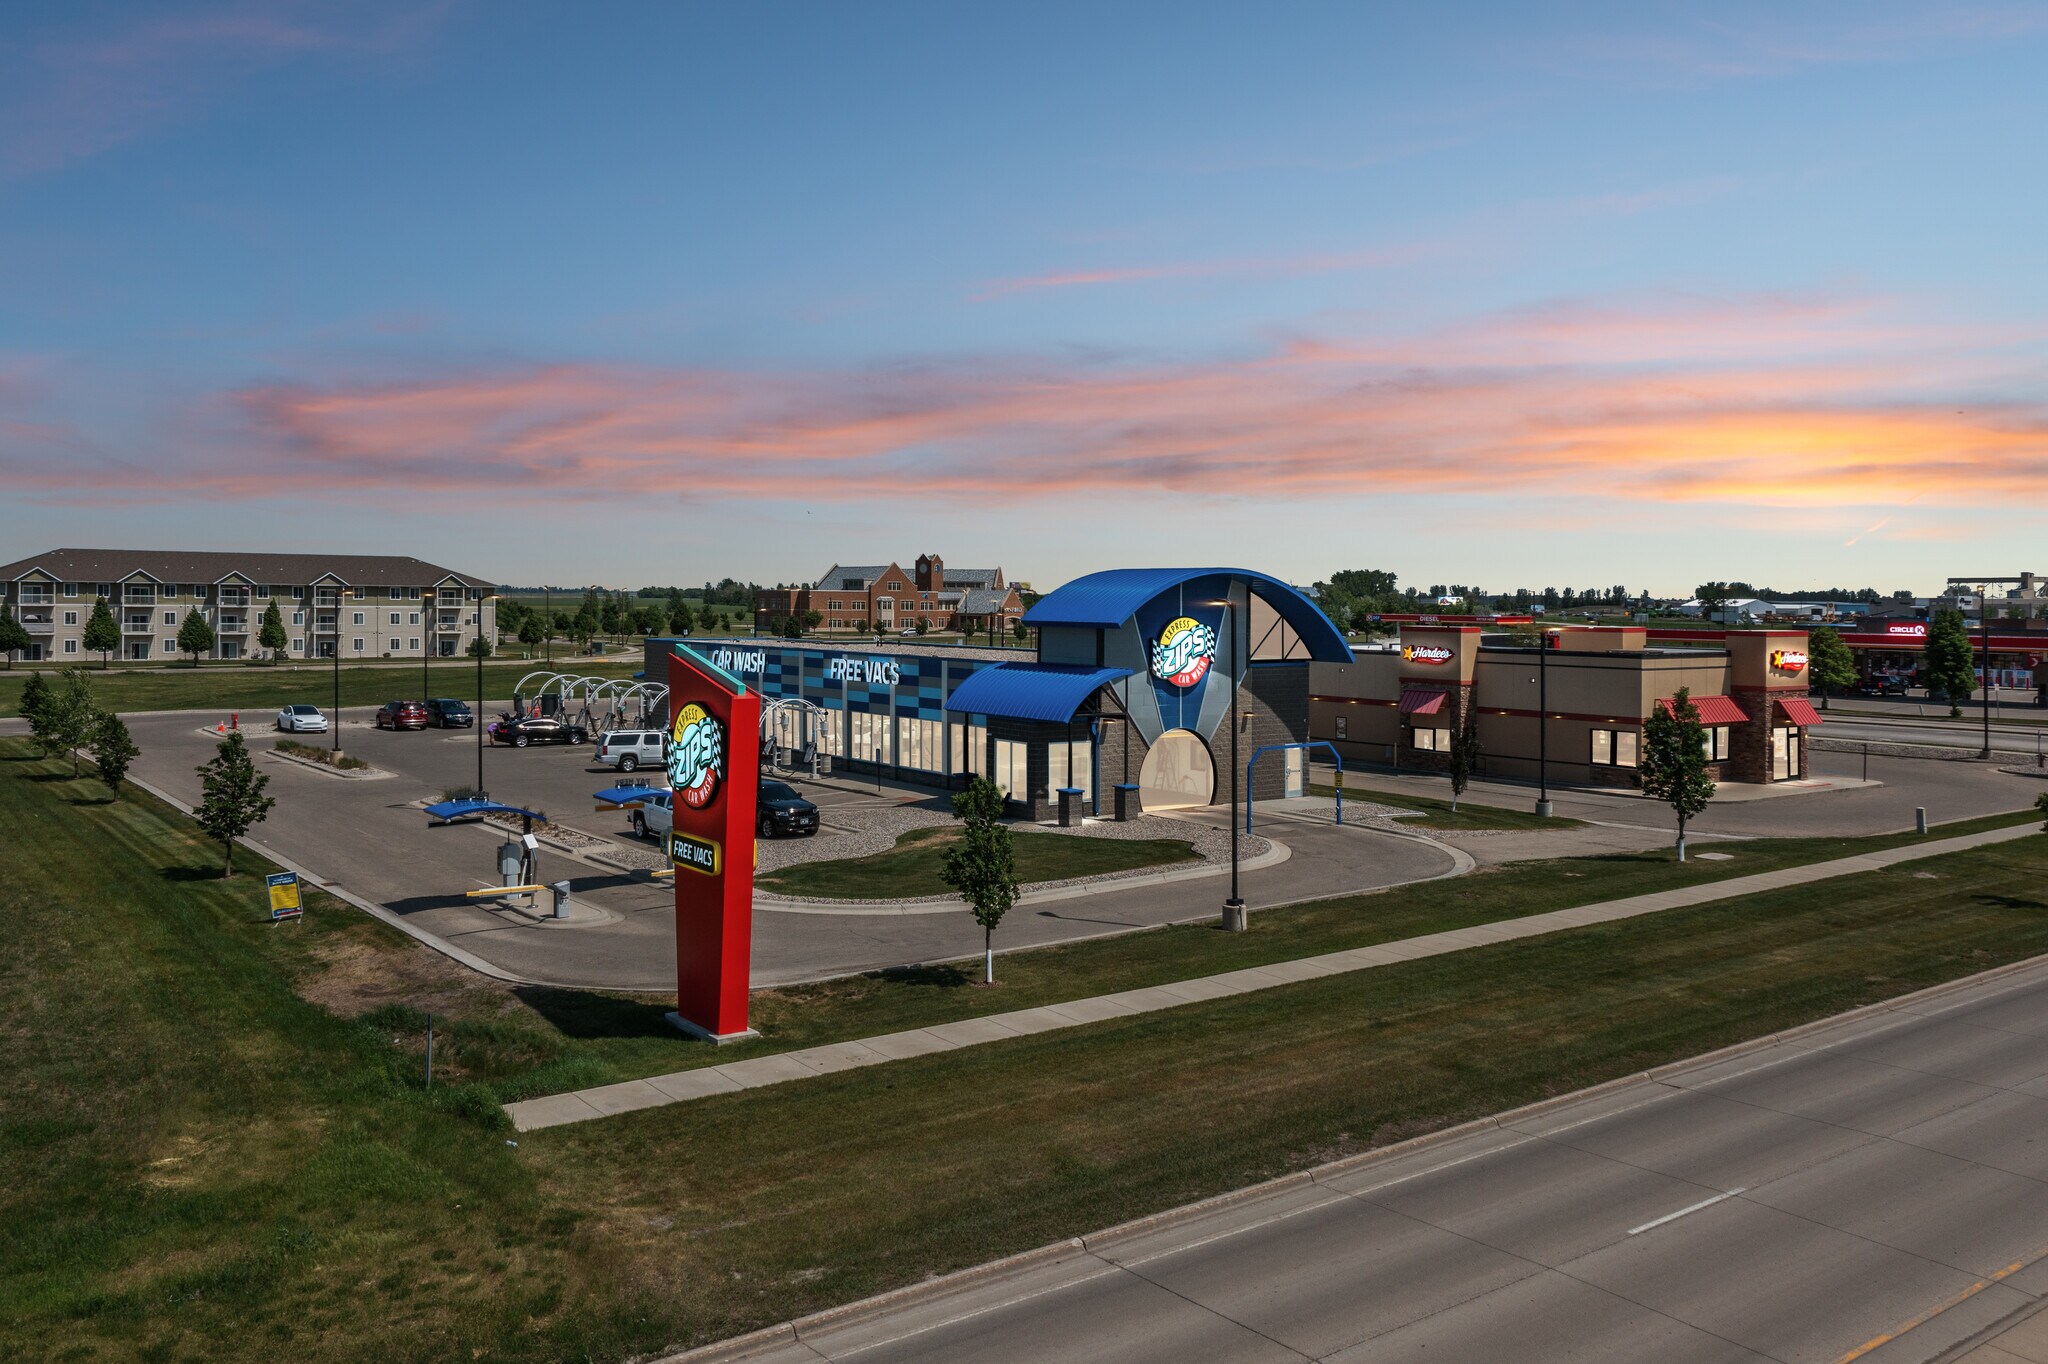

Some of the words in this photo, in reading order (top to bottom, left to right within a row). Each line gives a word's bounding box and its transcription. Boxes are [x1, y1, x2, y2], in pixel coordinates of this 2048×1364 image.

[1164, 619, 1190, 640] EXPRESS
[711, 649, 732, 671] CAR
[733, 650, 767, 674] WASH
[1162, 628, 1206, 674] ZIPS
[1410, 646, 1452, 659] Hardee's
[830, 658, 862, 682] FREE
[864, 660, 901, 686] VACS
[1178, 674, 1191, 684] CAR
[1191, 660, 1207, 681] WASH
[676, 707, 699, 735] EXPRESS
[675, 723, 712, 785] ZIPS
[687, 789, 699, 804] CAR
[699, 773, 714, 802] WASH
[673, 839, 693, 860] FREE
[693, 845, 713, 867] VACS
